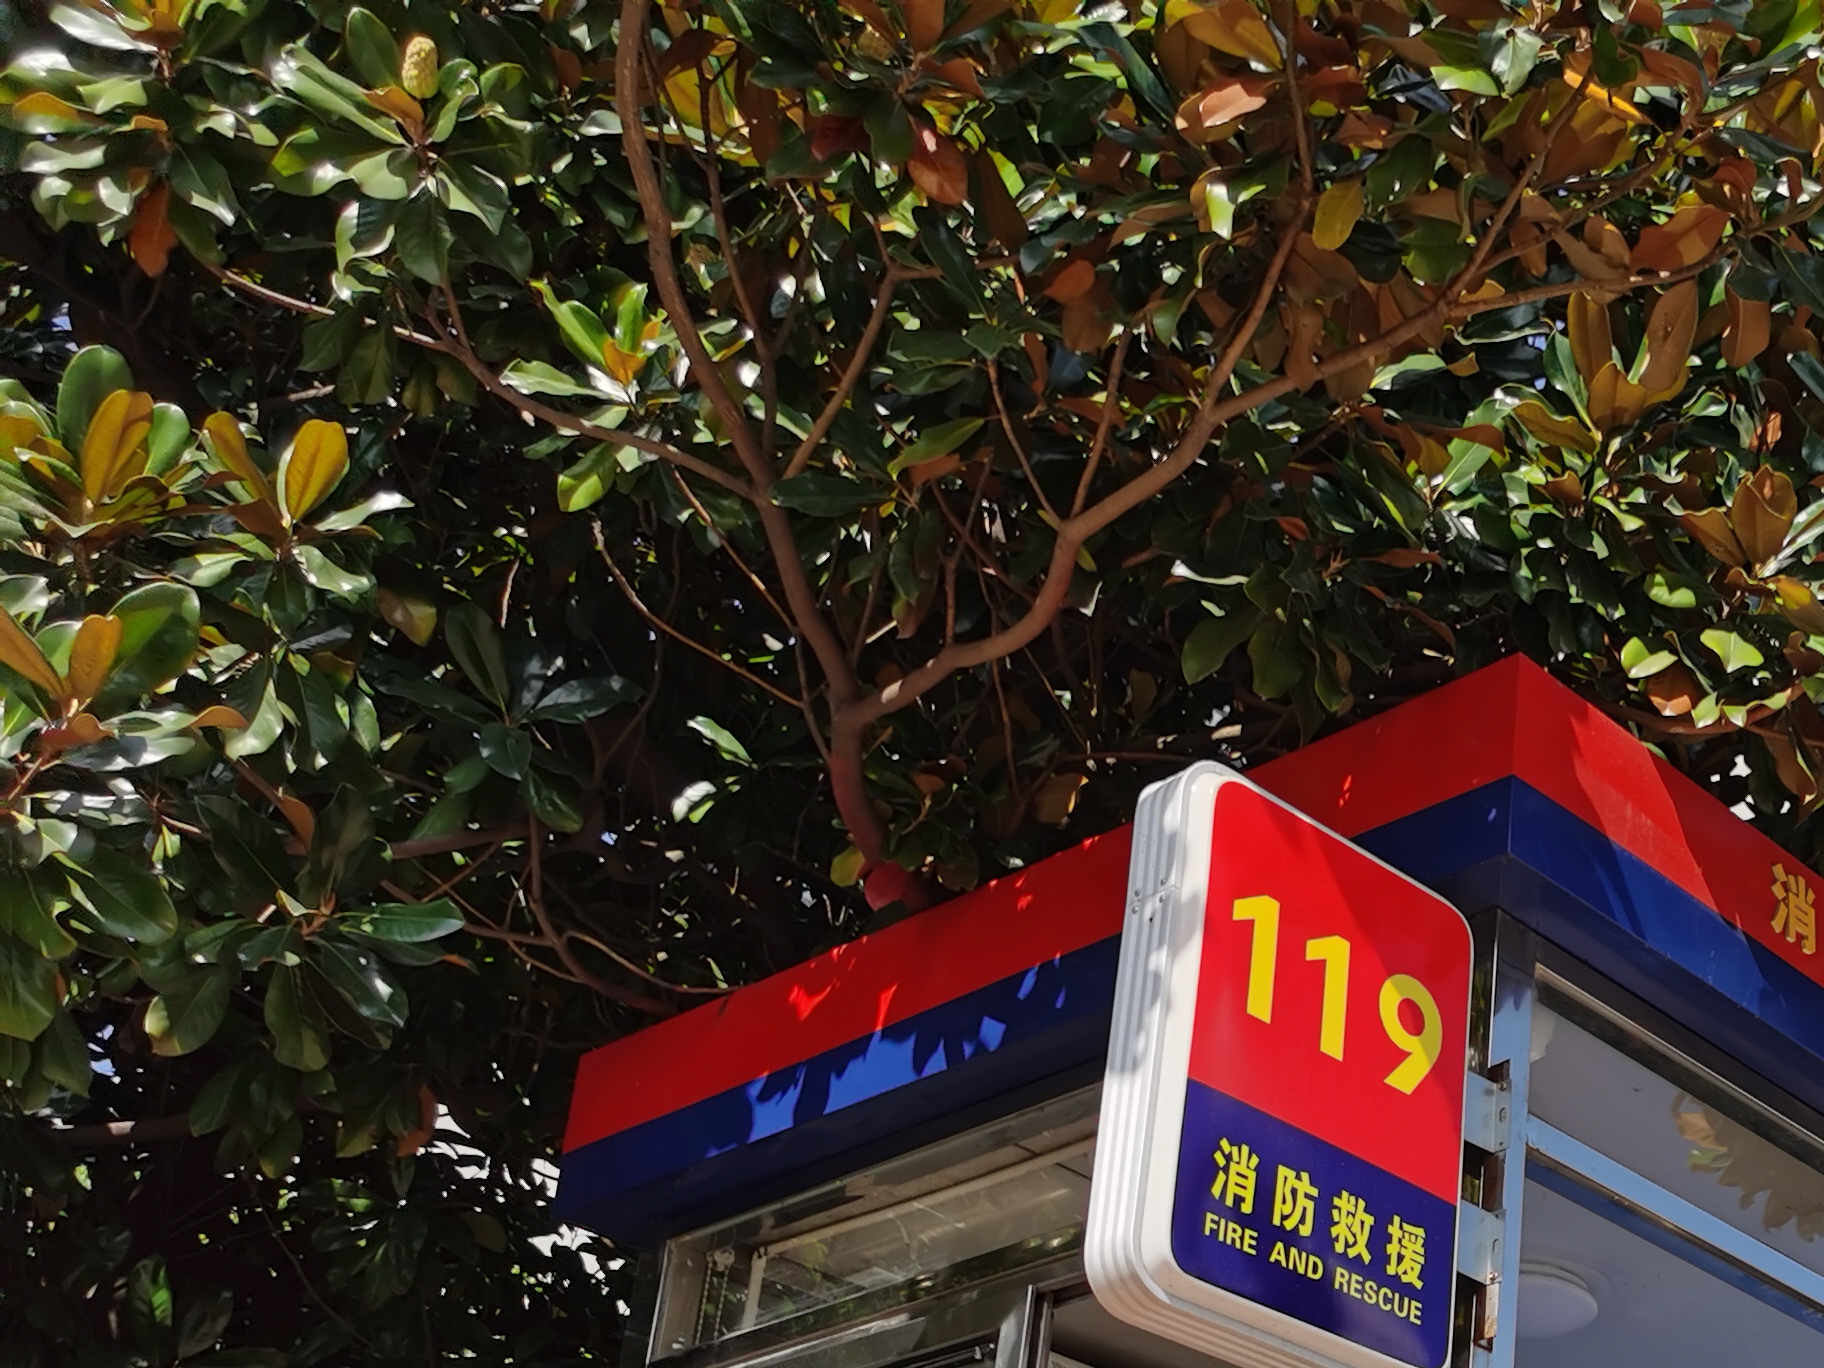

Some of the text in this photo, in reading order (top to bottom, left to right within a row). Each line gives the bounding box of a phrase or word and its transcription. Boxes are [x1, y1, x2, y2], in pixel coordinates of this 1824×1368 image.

[1232, 895, 1443, 1096] 119
[1205, 1211, 1423, 1326] FIRE AND RESCUE
[1210, 1136, 1428, 1290] 消防救援
